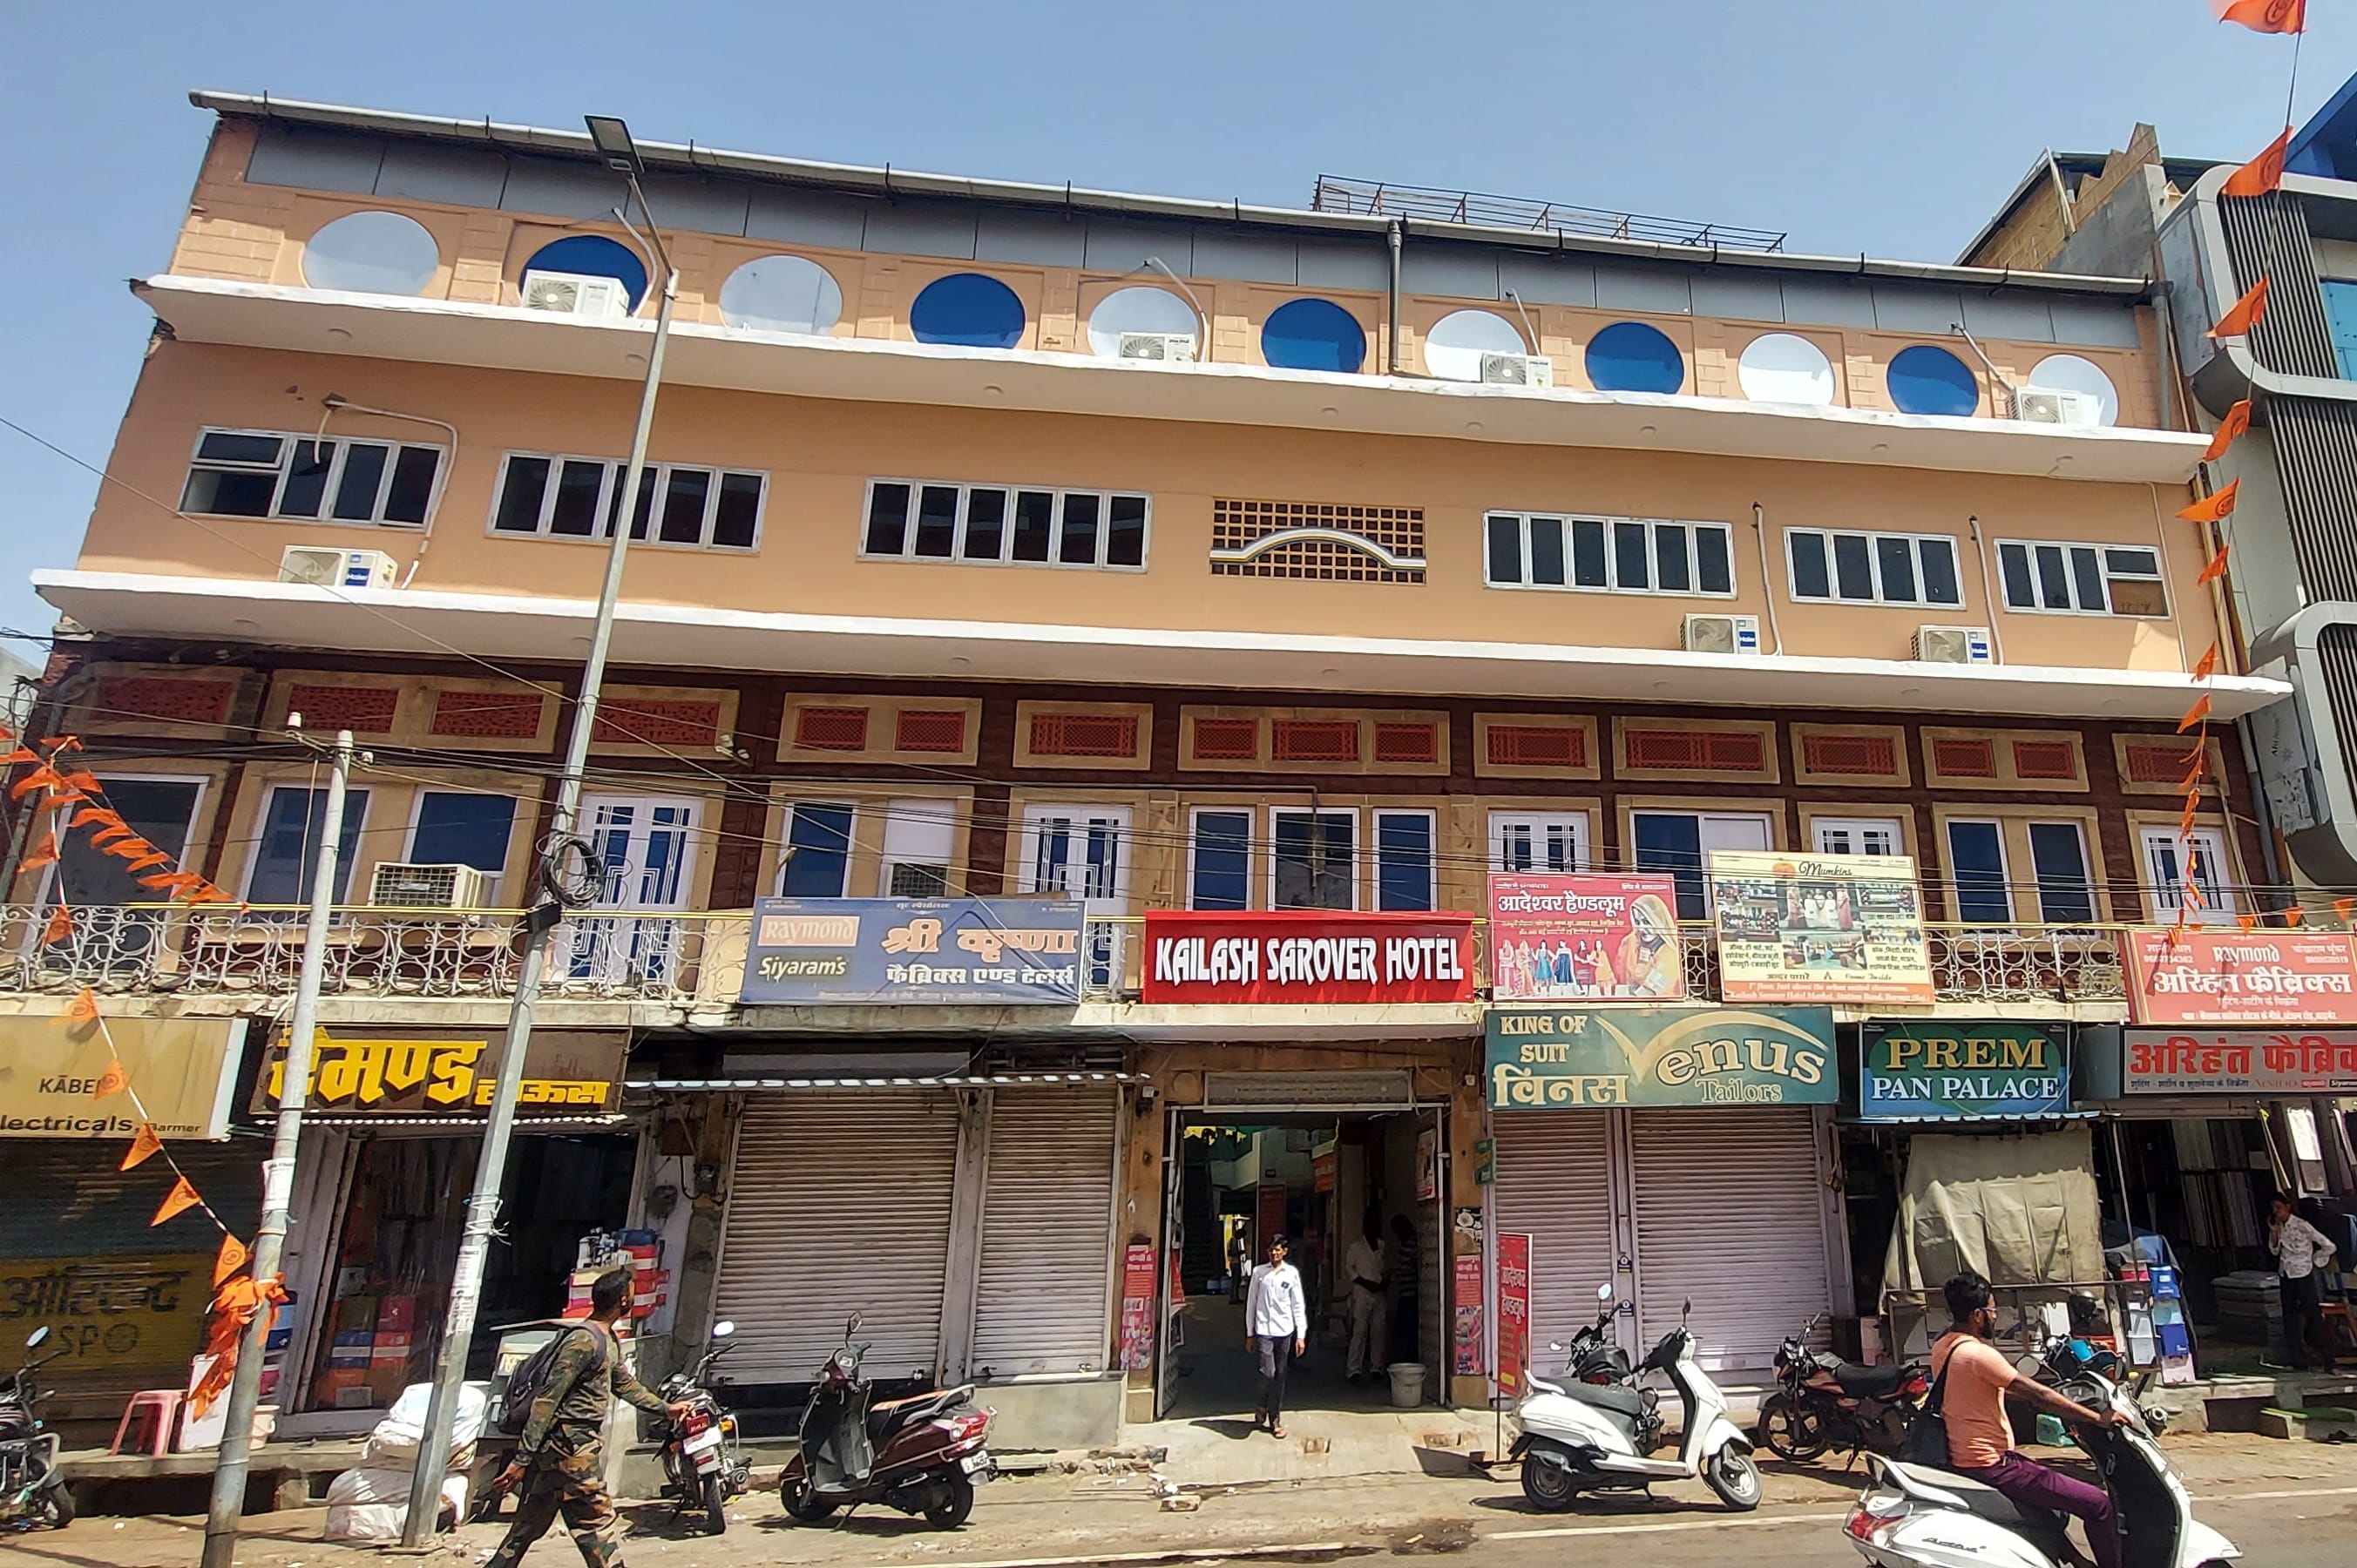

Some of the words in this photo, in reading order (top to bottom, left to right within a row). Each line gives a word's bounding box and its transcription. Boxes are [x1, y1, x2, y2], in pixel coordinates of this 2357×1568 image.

[766, 920, 855, 944] Raymond
[881, 918, 942, 955] श्री
[957, 929, 1079, 963] कृष्णा
[1155, 937, 1258, 986] KAILASH
[1266, 936, 1378, 986] SAROVER
[1385, 936, 1465, 986] HOTEL
[2211, 943, 2280, 967] Raymond
[972, 968, 1017, 984] एण्ड
[1021, 964, 1075, 984] टेलर्स
[2153, 966, 2240, 993] अरिहंत
[1500, 1016, 1554, 1035] KING
[1559, 1016, 1588, 1035] OF
[1520, 1044, 1570, 1064] SUIT
[1593, 1010, 1830, 1086] Venus
[1885, 1038, 2047, 1070] PREM
[2130, 1036, 2253, 1074] अरिहंत
[1493, 1063, 1629, 1107] विनस
[1695, 1078, 1783, 1102] Tailors
[1871, 1077, 1932, 1099] PAN
[1940, 1077, 2059, 1099] PALACE
